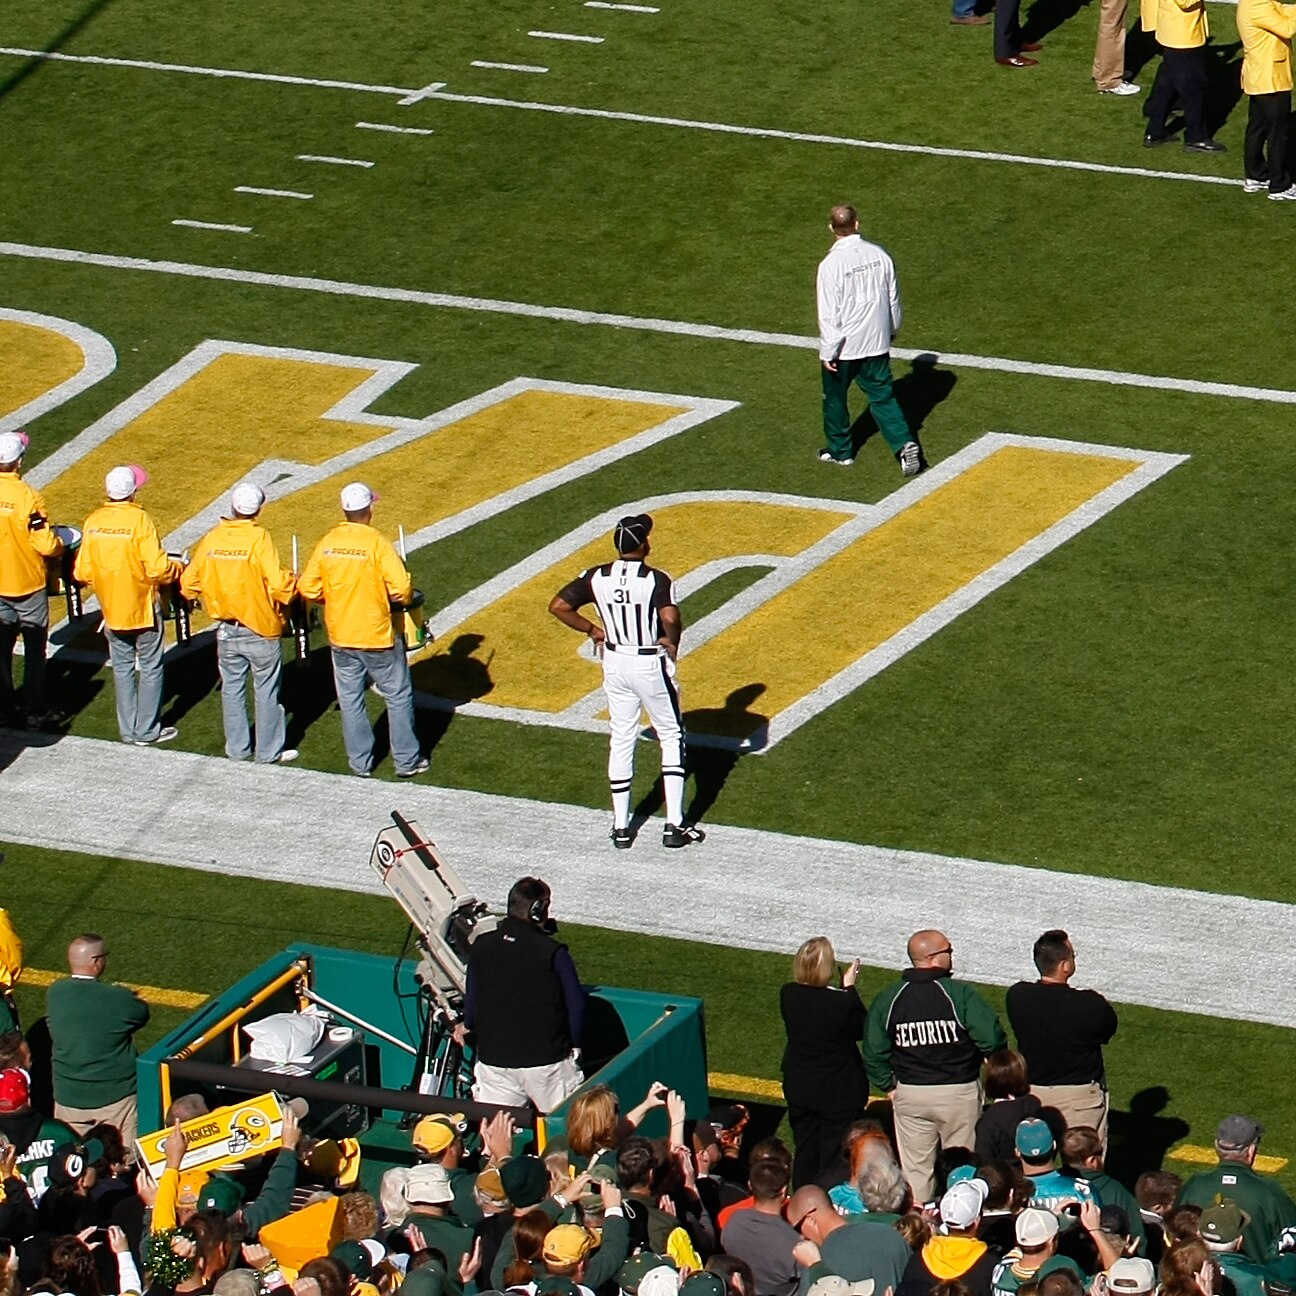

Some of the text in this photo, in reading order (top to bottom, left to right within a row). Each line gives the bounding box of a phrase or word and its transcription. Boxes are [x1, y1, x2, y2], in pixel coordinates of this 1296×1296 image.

[614, 589, 631, 604] 31
[895, 1020, 959, 1048] SECURITY
[184, 1122, 221, 1144] ACKERS
